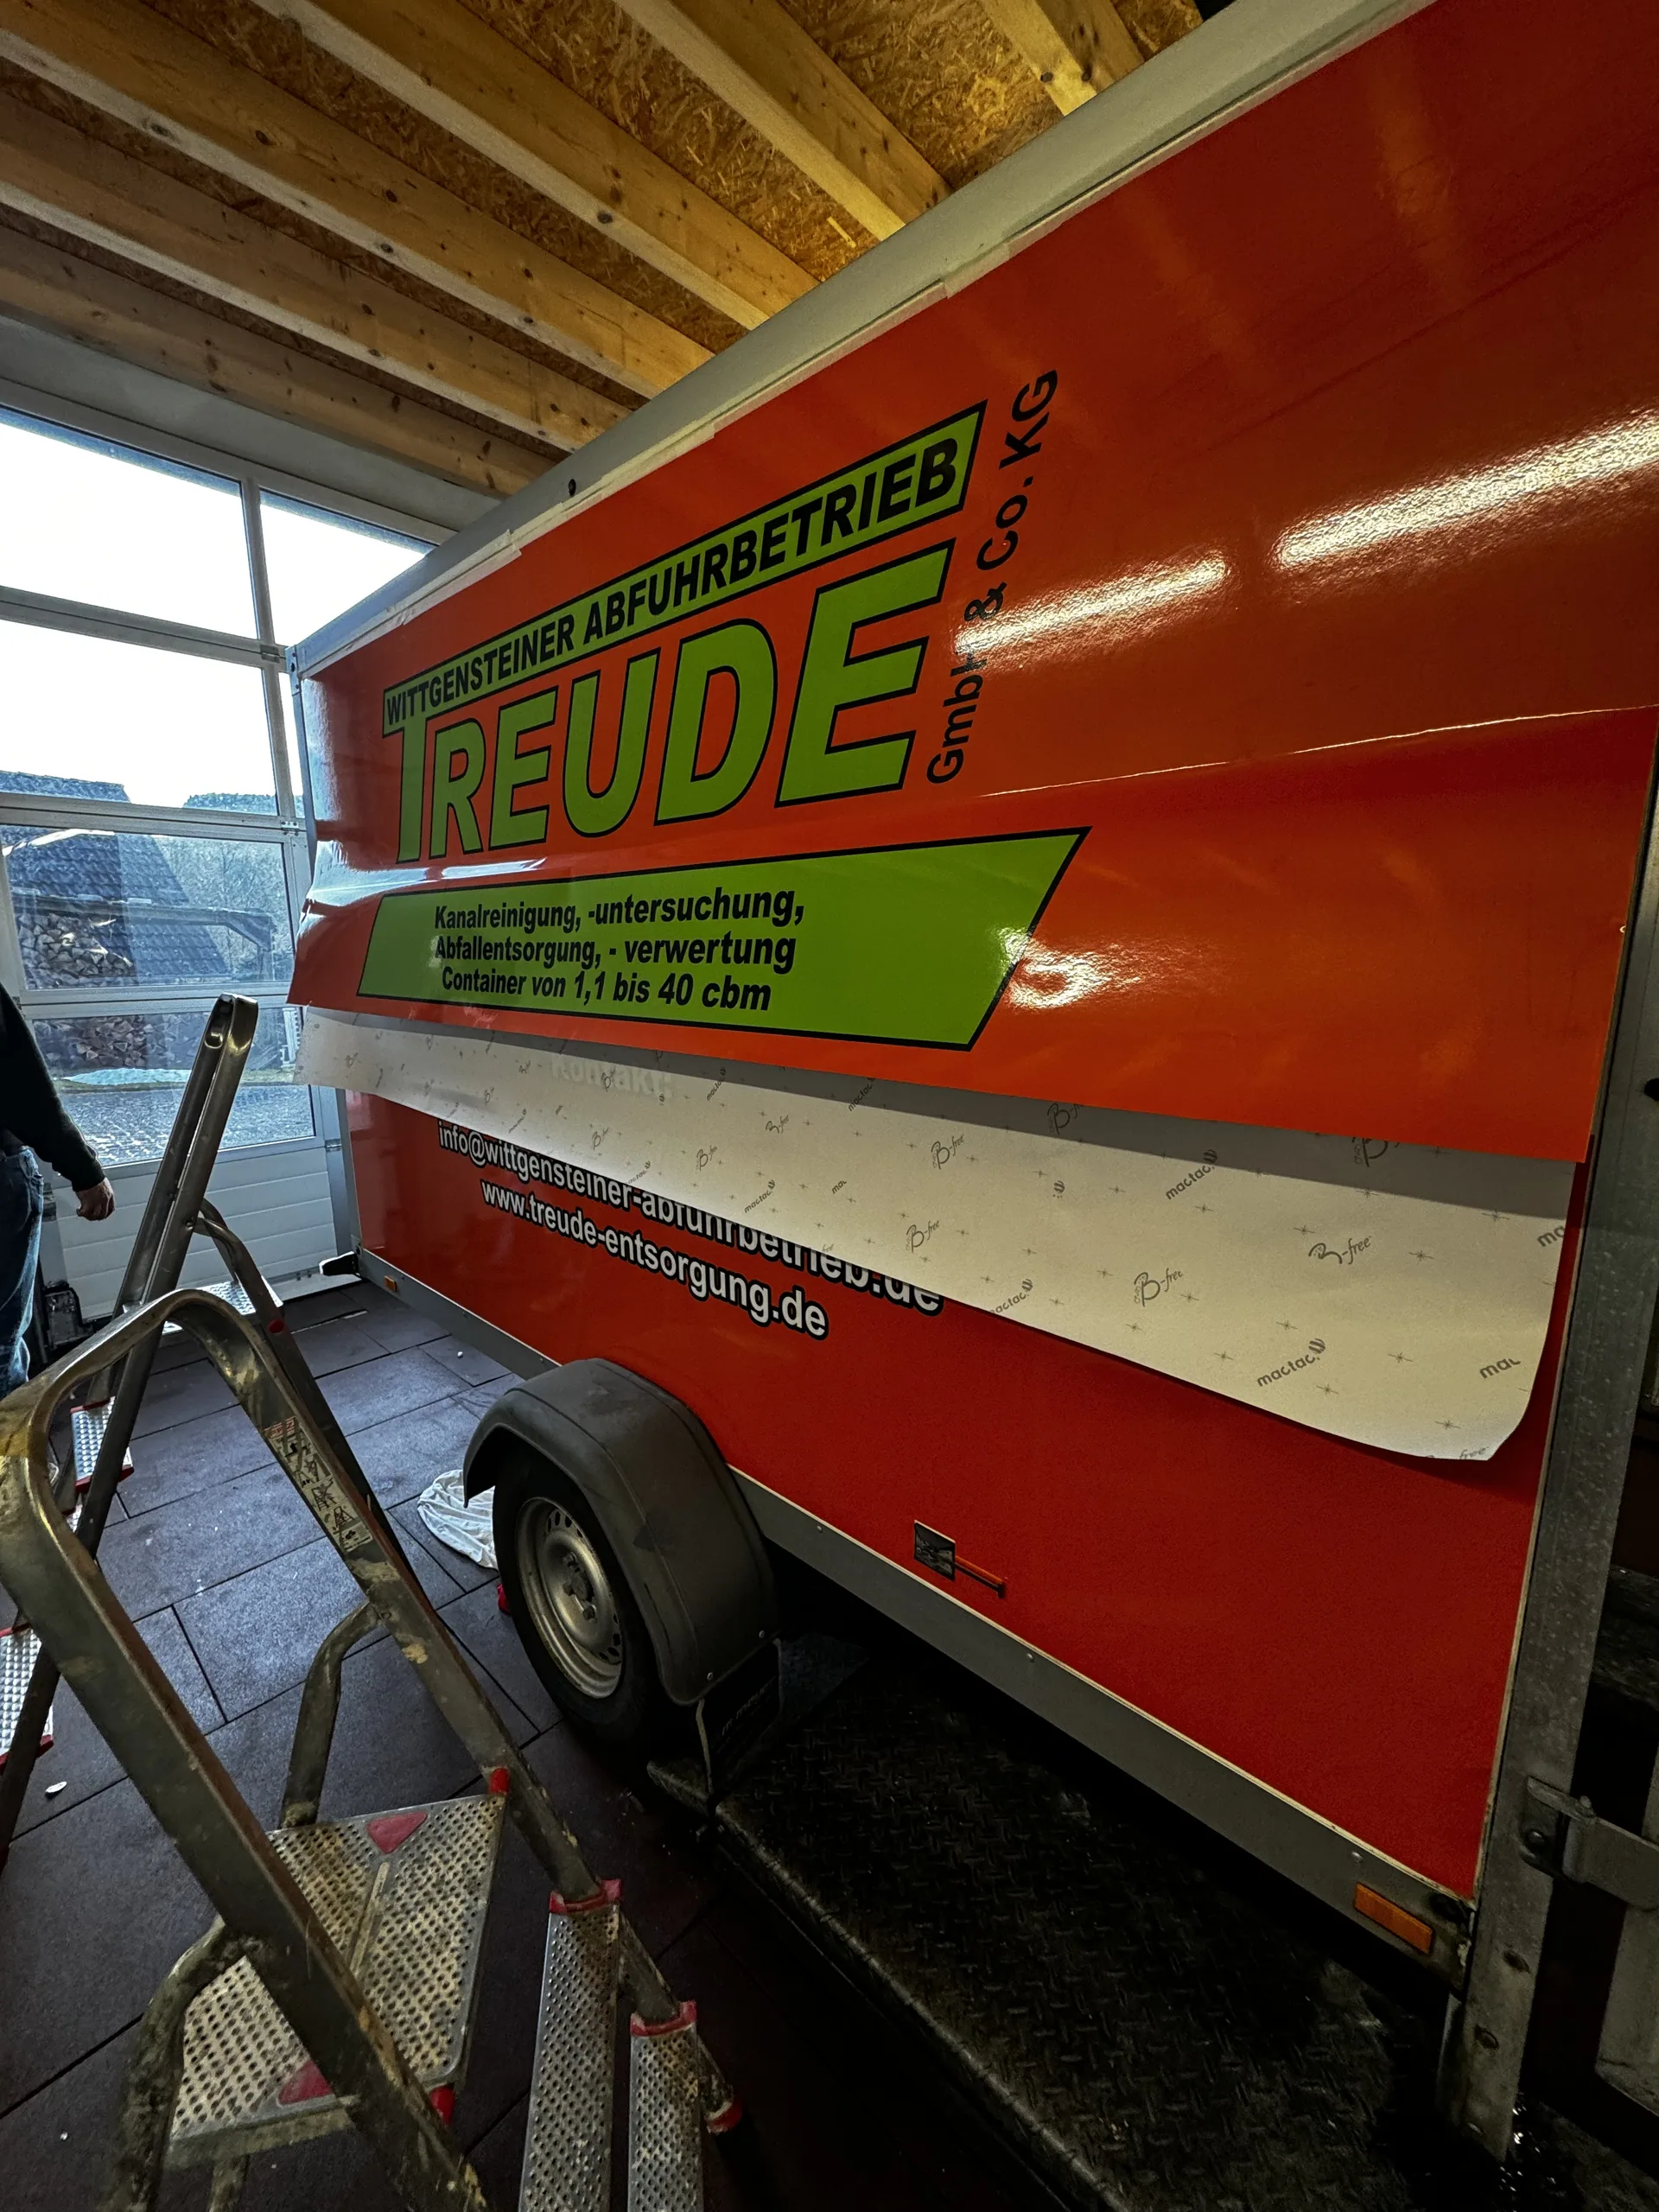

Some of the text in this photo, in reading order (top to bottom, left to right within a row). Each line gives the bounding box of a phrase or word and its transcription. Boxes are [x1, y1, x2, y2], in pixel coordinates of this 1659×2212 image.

[964, 582, 1007, 621] &
[999, 370, 1058, 467] KG
[387, 437, 959, 726] WITTGENSTEINER ABFUHRBETRIEB
[383, 537, 957, 864] TREUDE
[435, 887, 804, 934] Kanalreinigung, -untersuchung,
[435, 936, 601, 970] Abfallentsorgung,
[625, 931, 797, 975] verwertung
[442, 966, 772, 1011] Container von 1,1 bis 40 cbm
[480, 1179, 827, 1338] www.treude-entsorgung.de
[1256, 1353, 1316, 1388] mactac
